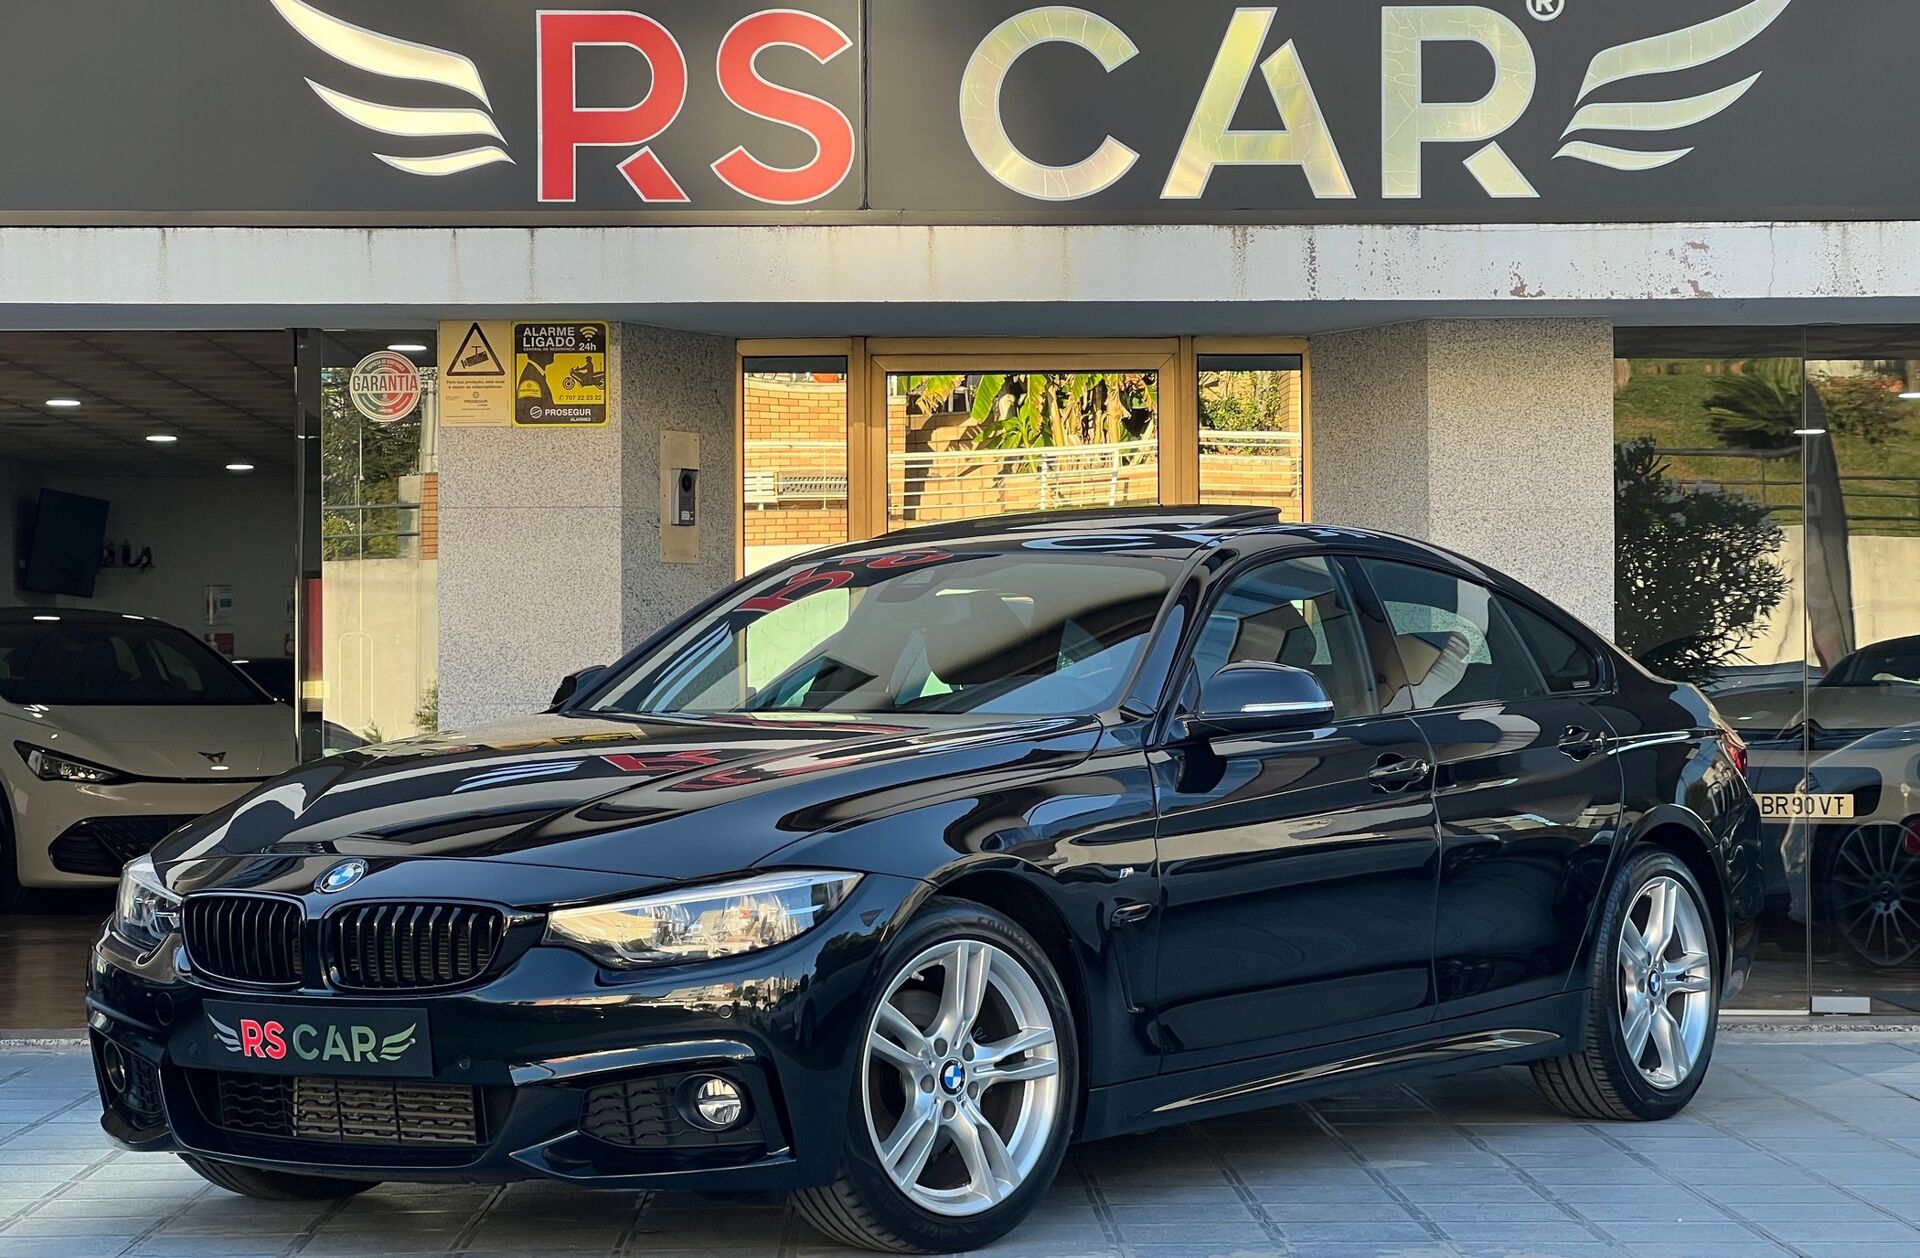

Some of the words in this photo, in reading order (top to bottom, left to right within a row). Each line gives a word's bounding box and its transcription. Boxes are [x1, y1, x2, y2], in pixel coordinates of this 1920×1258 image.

[536, 9, 856, 205] RS
[959, 5, 1540, 201] CAR
[523, 327, 575, 336] ALARME
[523, 337, 576, 347] LIGADO
[579, 342, 597, 351] 24h
[352, 375, 418, 392] GARANTIA
[544, 408, 591, 416] PROSEGUR
[1761, 796, 1788, 815] BR
[1792, 796, 1815, 815] 90
[1819, 796, 1845, 815] VT
[240, 1019, 287, 1060] RS
[292, 1023, 378, 1063] CAR
